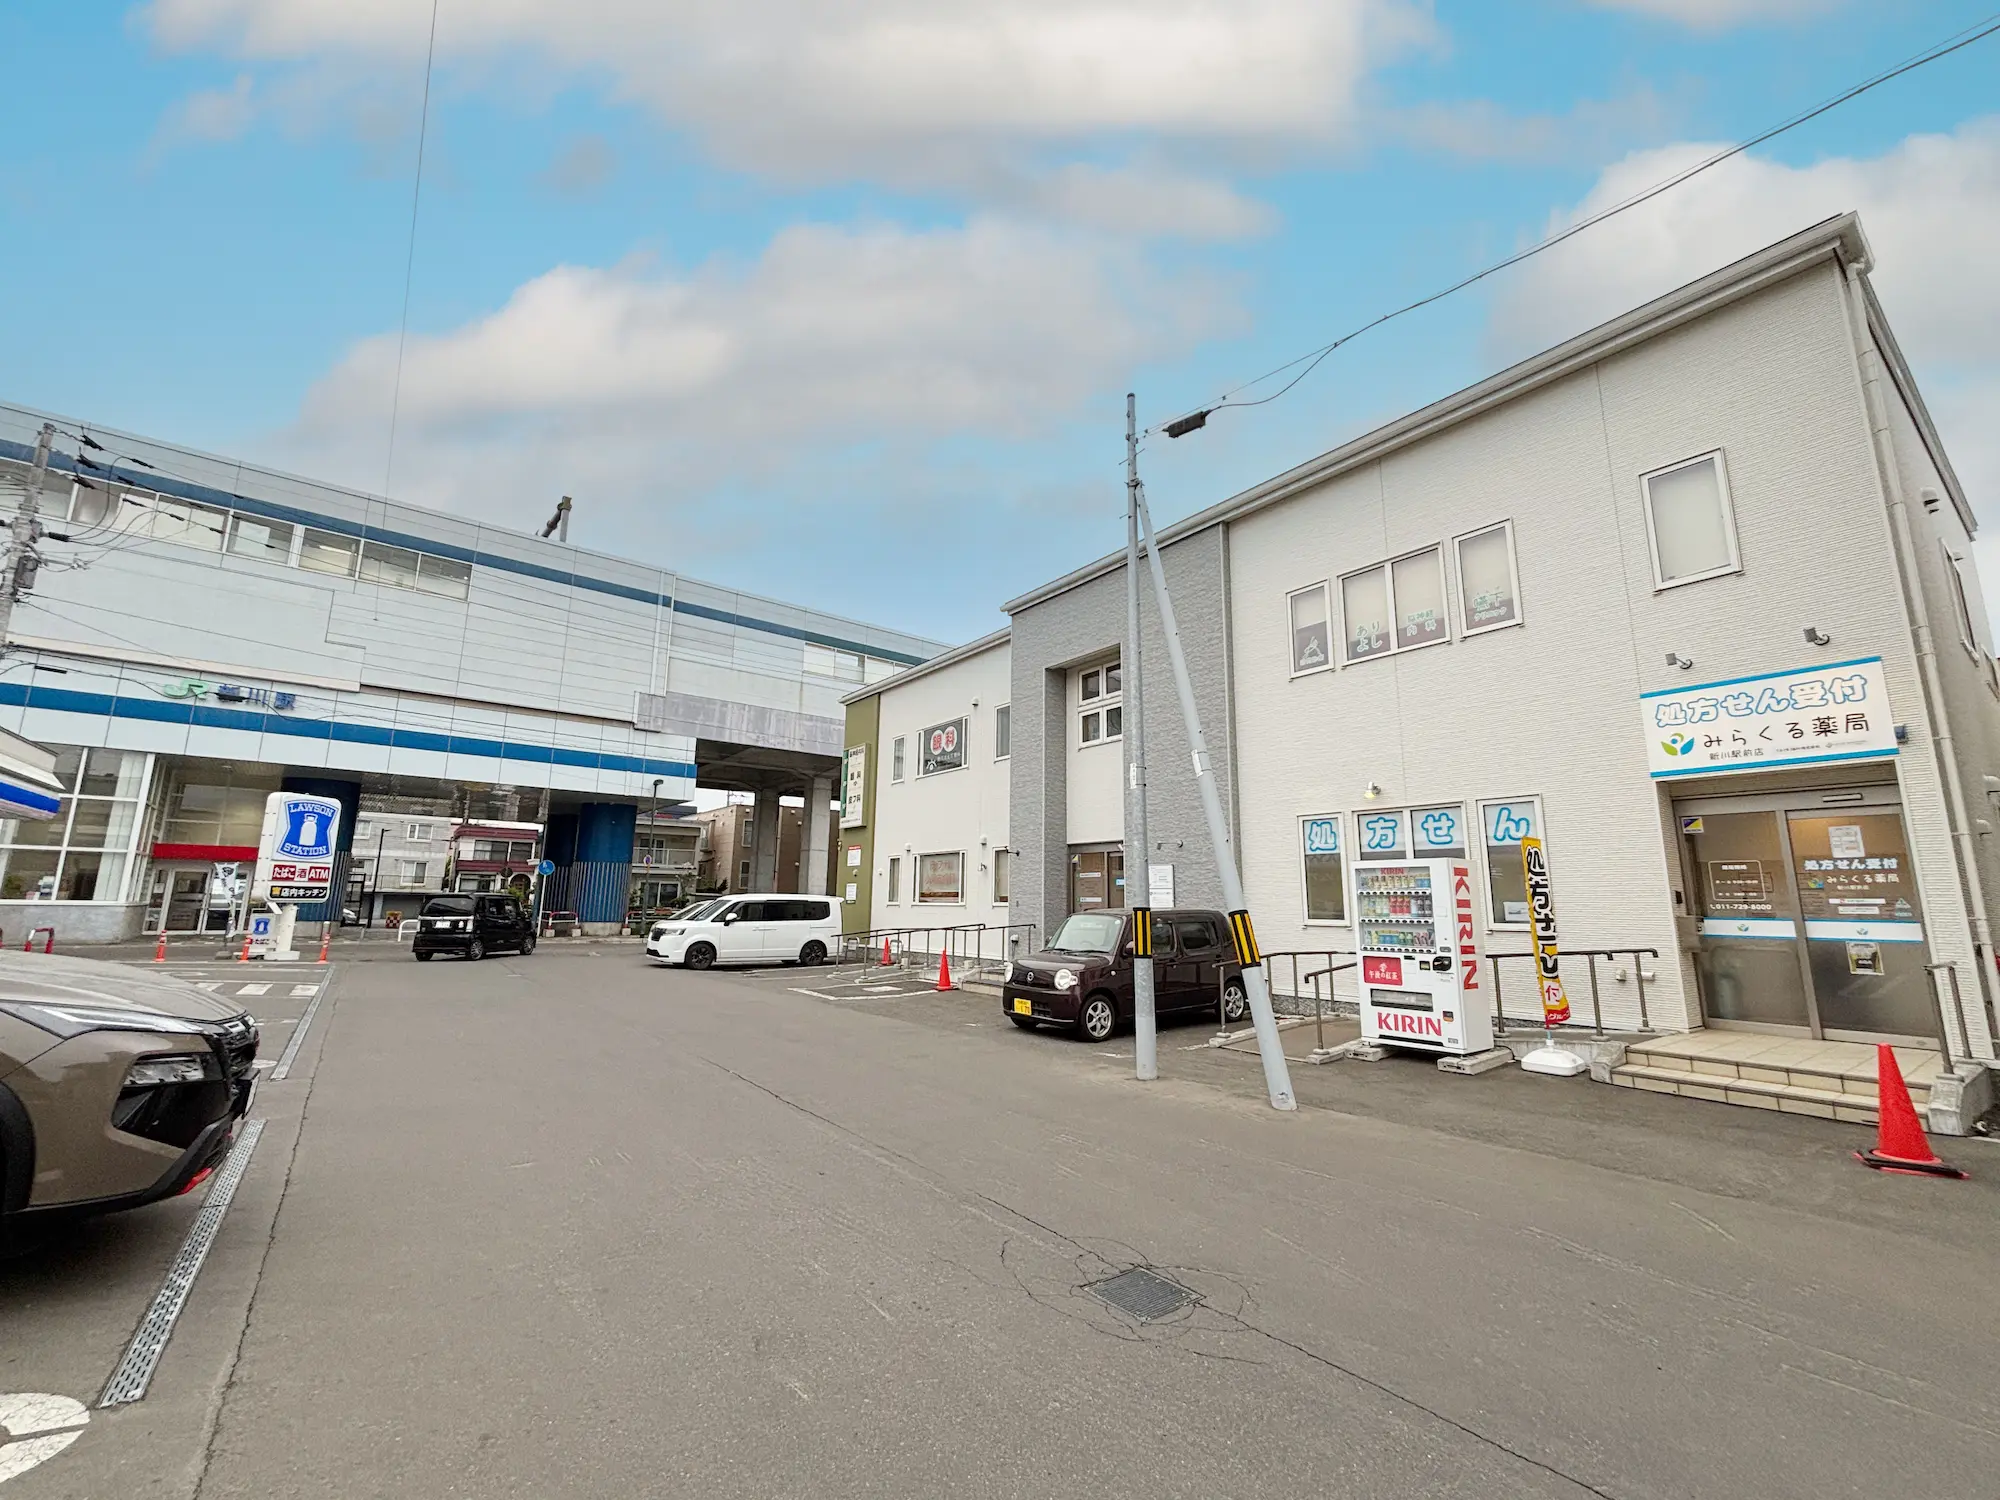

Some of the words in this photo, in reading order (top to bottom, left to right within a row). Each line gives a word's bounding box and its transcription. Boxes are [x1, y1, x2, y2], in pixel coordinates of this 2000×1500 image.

[1655, 673, 1868, 728] 処方せん受付
[1703, 712, 1870, 748] みらくる薬局
[1709, 747, 1765, 761] 新川駅前店
[289, 802, 334, 818] LAWSON
[283, 842, 327, 857] STATION
[273, 865, 296, 879] たばこ
[309, 868, 329, 879] ATM
[1380, 867, 1405, 875] KIRIN
[280, 887, 327, 898] 店内キッチン
[1453, 866, 1479, 991] KIRIN
[1368, 969, 1399, 981] 午後の紅茶
[1377, 1011, 1443, 1037] KIRIN
